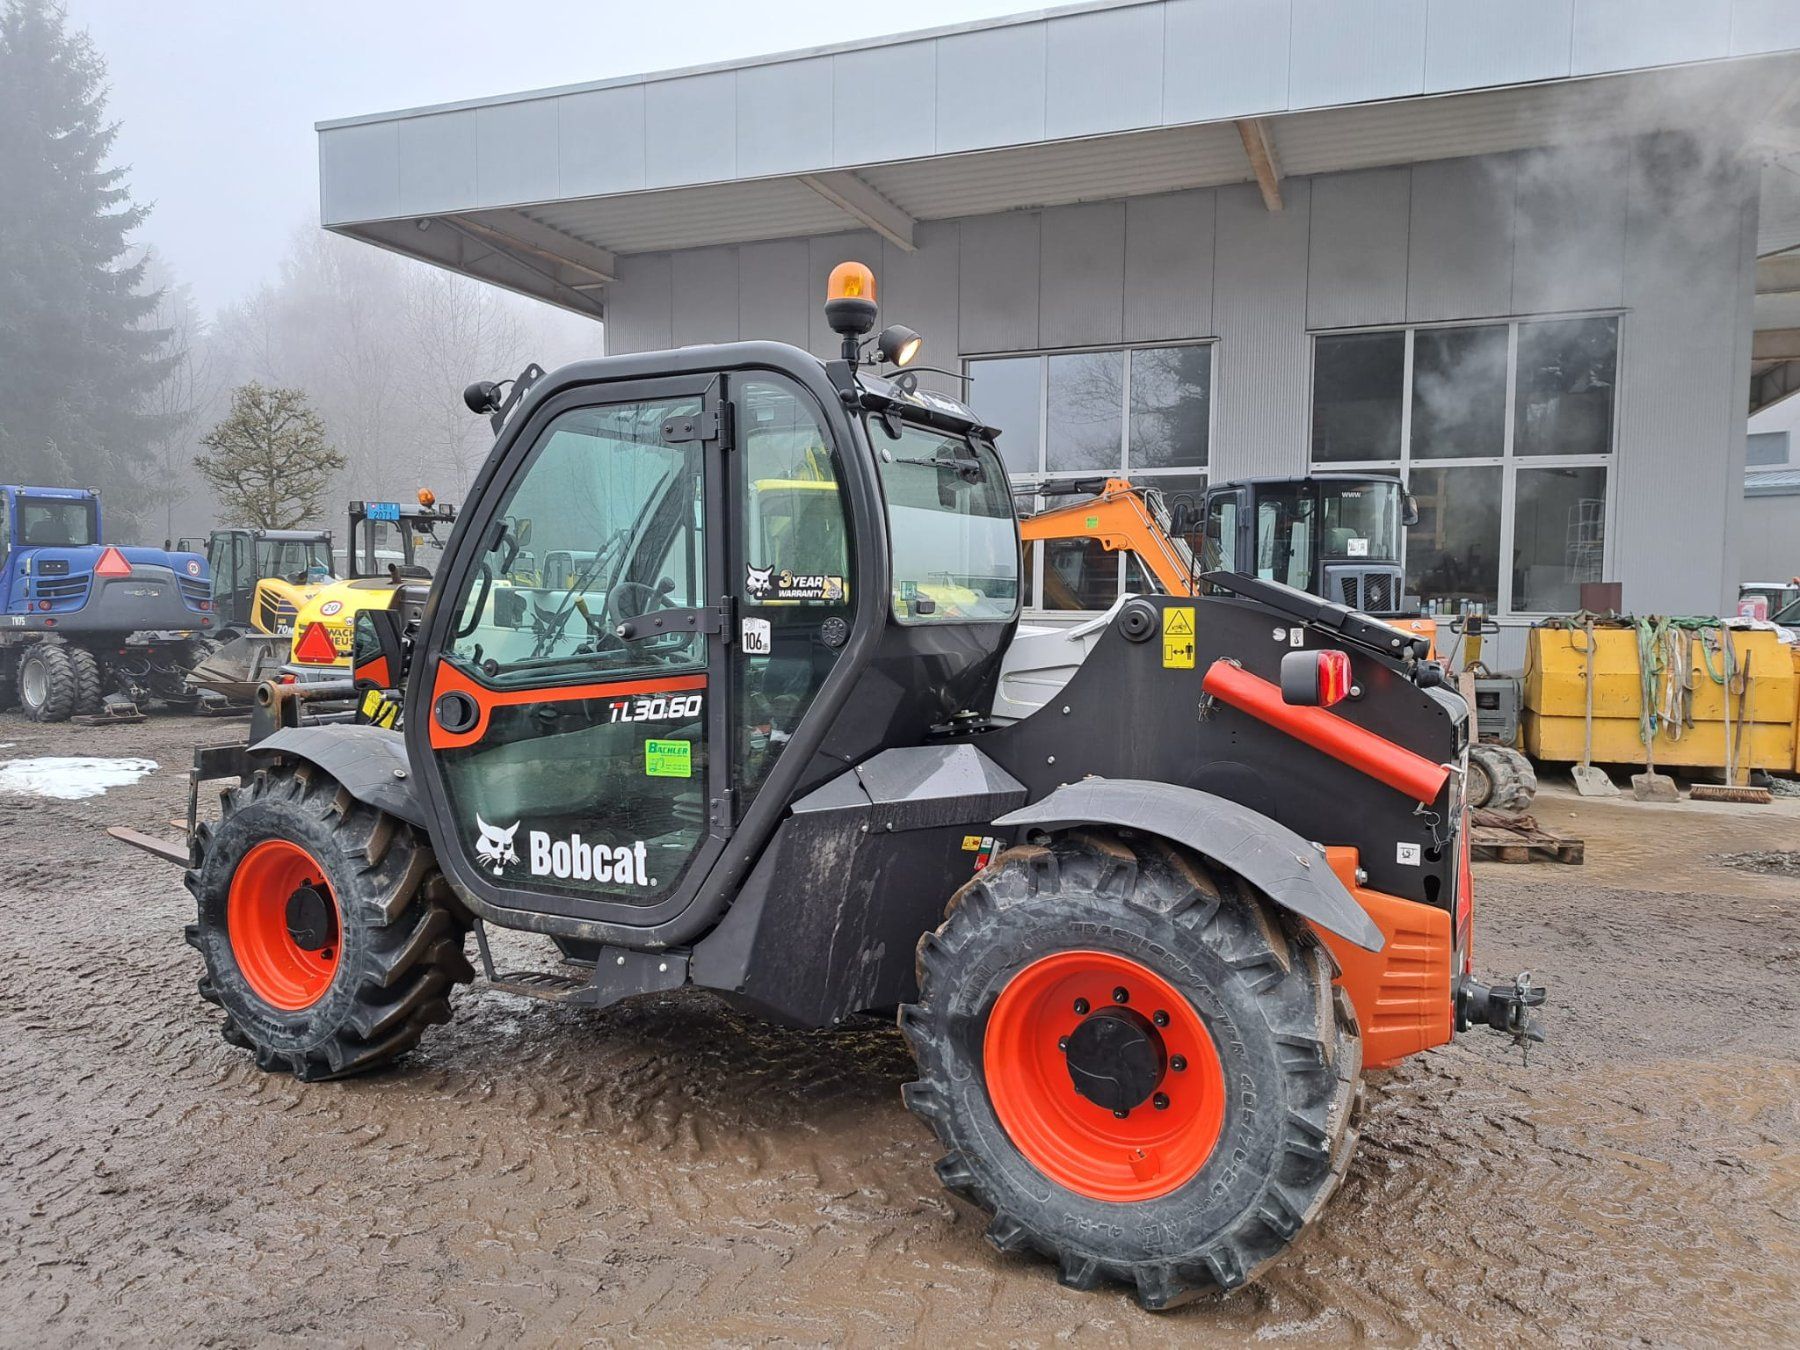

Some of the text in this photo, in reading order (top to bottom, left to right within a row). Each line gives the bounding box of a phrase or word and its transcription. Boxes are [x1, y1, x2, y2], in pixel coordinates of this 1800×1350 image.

[792, 576, 823, 588] YEAR
[778, 589, 824, 598] WARRANTY
[324, 604, 339, 612] 20
[331, 637, 355, 646] EUS
[744, 632, 762, 650] 106
[609, 695, 703, 723] TL30.60
[529, 830, 648, 886] Bobcat
